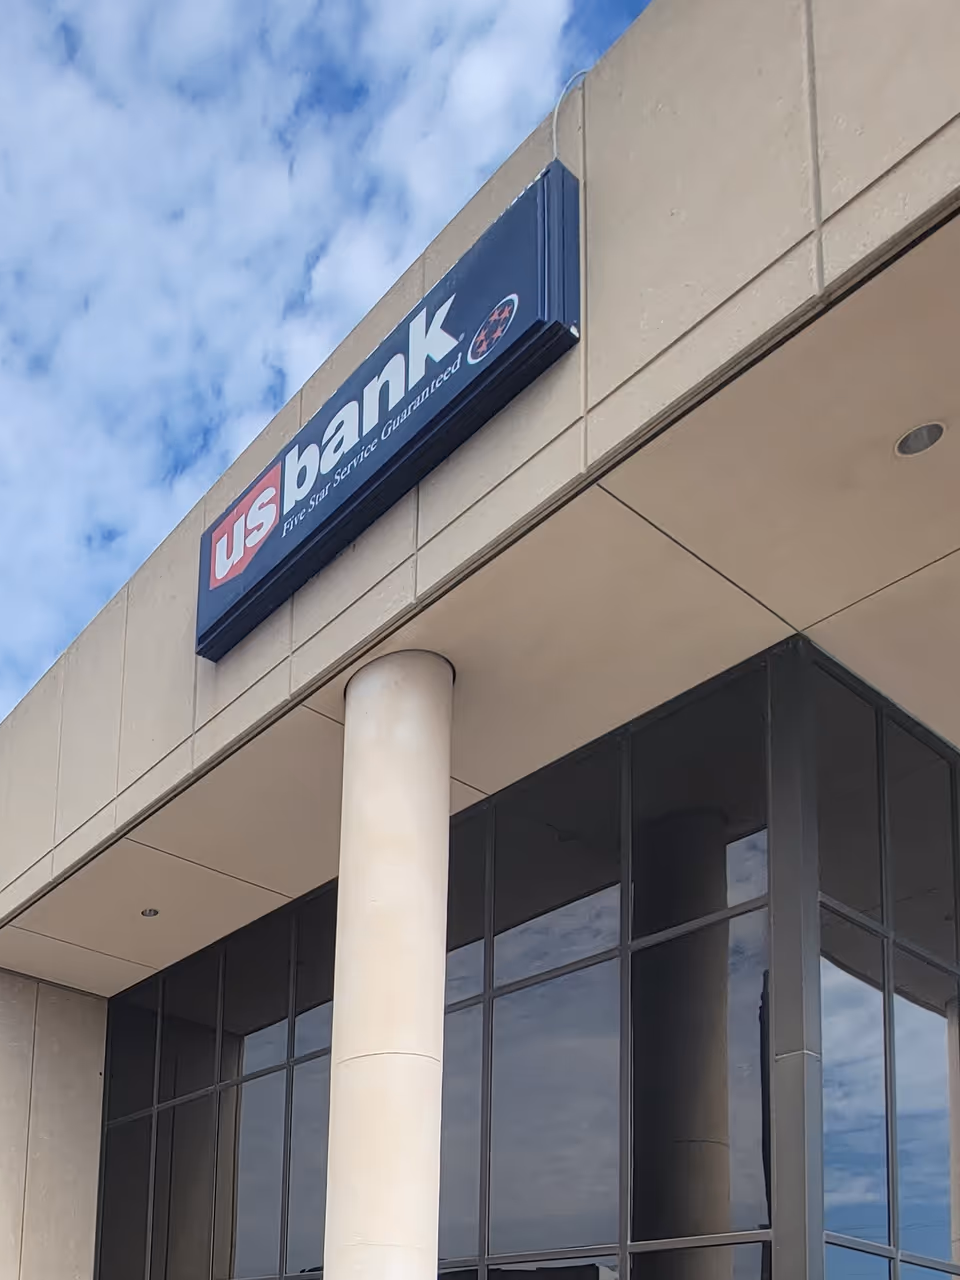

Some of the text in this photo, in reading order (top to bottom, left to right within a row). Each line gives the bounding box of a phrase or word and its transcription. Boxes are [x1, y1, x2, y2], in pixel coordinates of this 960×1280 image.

[281, 353, 462, 538] Five Star Service Guaranteed
